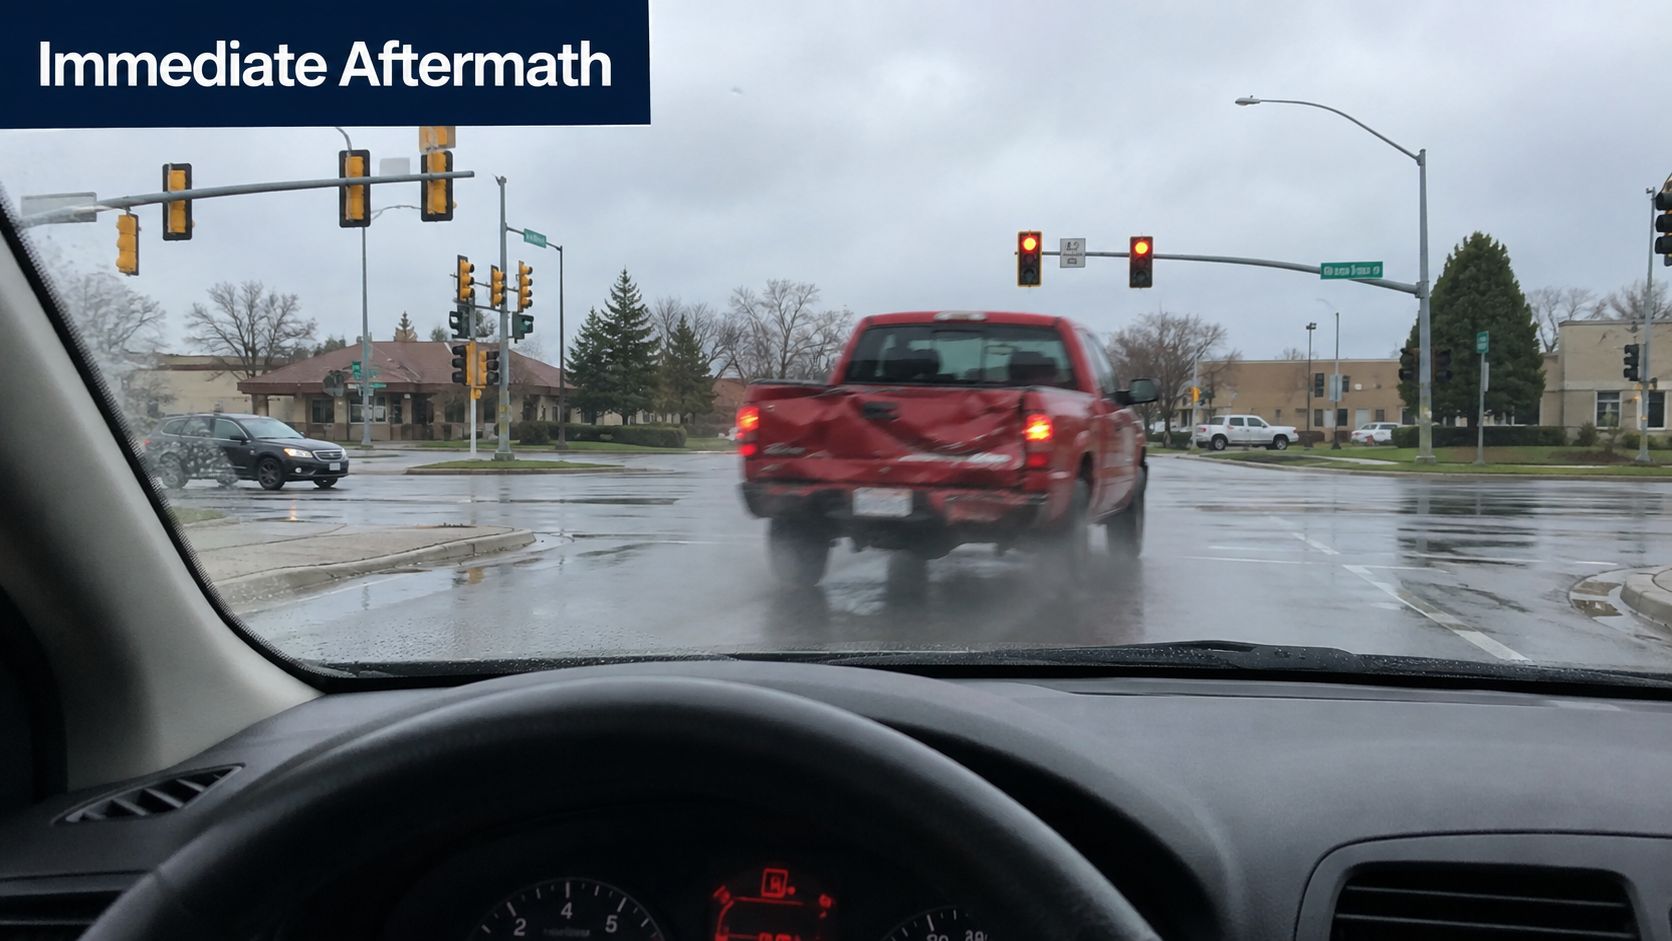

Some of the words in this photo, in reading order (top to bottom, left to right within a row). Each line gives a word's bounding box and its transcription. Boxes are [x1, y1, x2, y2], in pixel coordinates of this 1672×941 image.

[560, 902, 573, 919] 4
[513, 918, 527, 937] 2
[605, 914, 618, 933] 5
